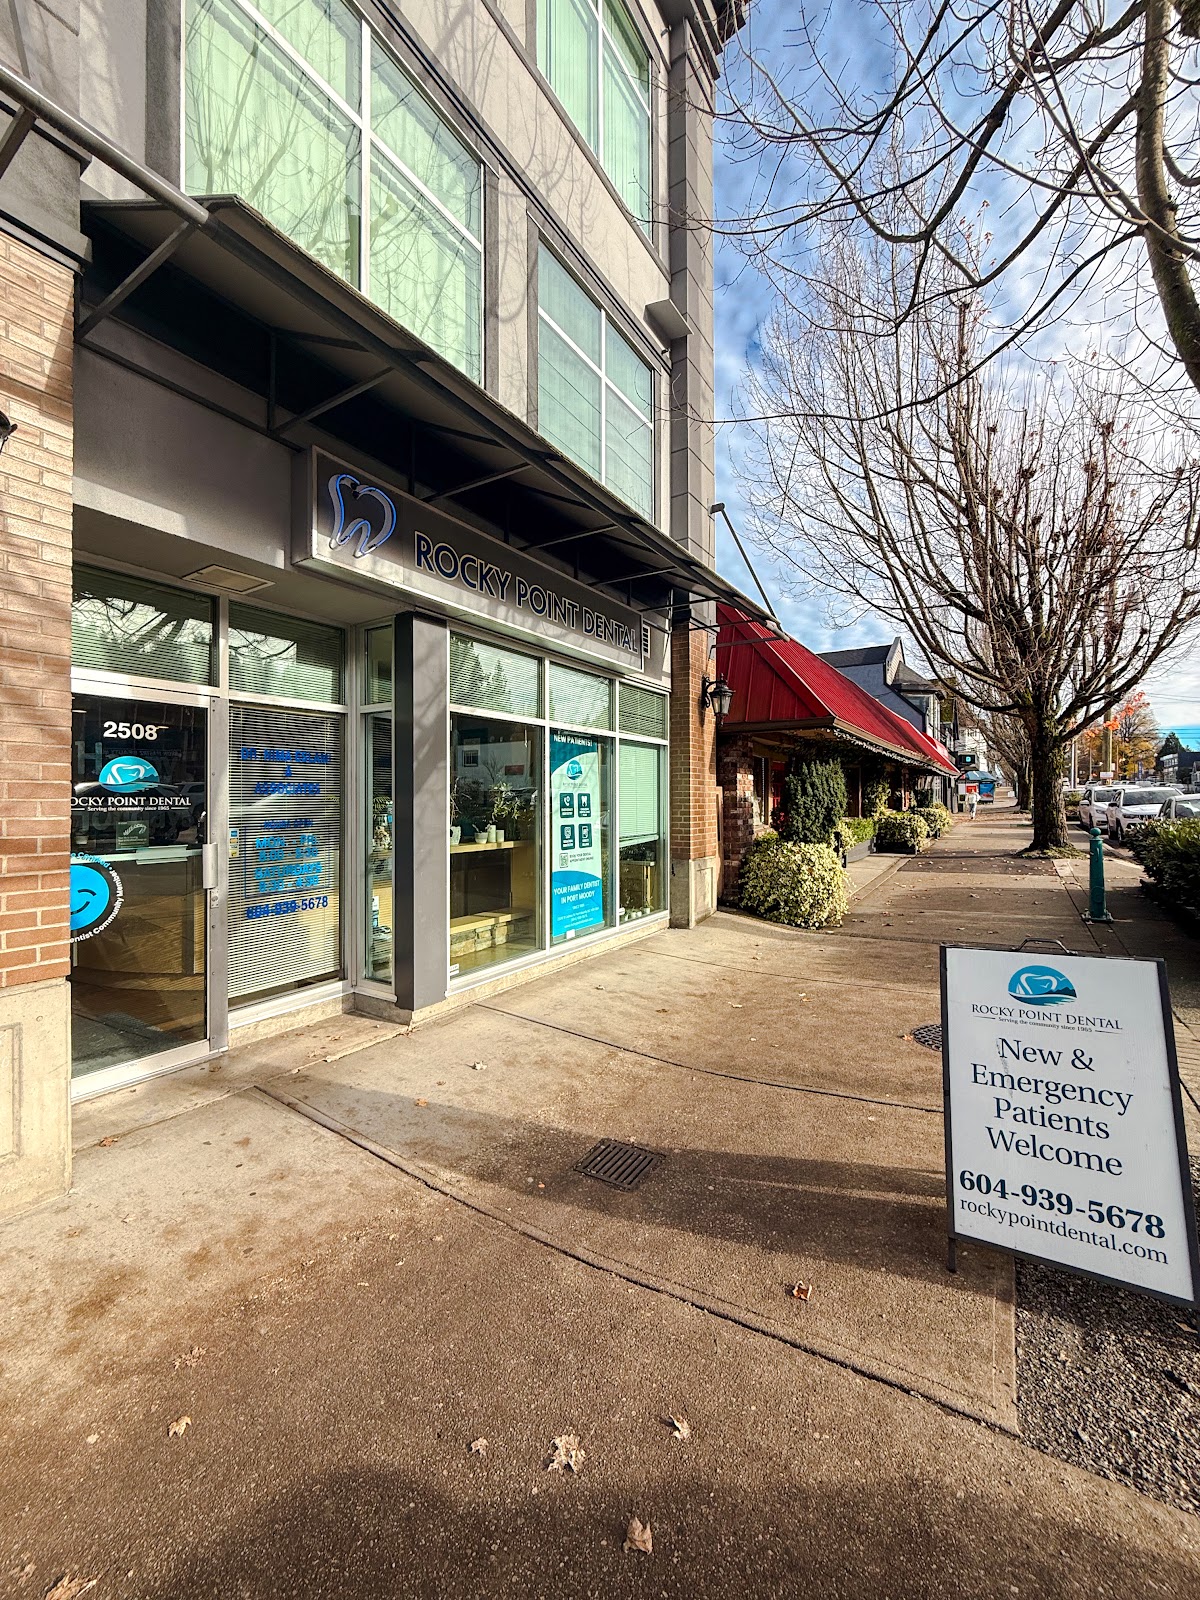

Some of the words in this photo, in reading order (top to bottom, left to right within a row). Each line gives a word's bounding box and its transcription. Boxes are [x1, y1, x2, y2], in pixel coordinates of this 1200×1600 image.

[414, 530, 512, 601] ROCKY
[515, 576, 579, 629] POINT
[582, 606, 639, 654] DENTAL
[103, 721, 158, 740] 2508
[553, 734, 567, 743] NEW
[254, 782, 321, 795] ASSOCIATES
[70, 796, 105, 806] OCKY
[107, 796, 147, 806] POINT
[149, 796, 192, 807] DENTAL
[254, 862, 322, 880] SATURDAYS
[553, 886, 568, 896] YOUR
[567, 882, 583, 893] FAMILY
[583, 880, 601, 890] DENTIST
[560, 896, 567, 905] IN
[566, 893, 579, 904] PORT
[578, 890, 595, 900] MOODY
[246, 896, 328, 919] 604-939-5678
[70, 931, 94, 944] entist
[92, 897, 125, 935] Community
[971, 1003, 1015, 1017] ROCKY
[1018, 1009, 1062, 1023] POINT
[1066, 1014, 1123, 1030] DENTAL
[998, 1016, 1019, 1025] Serving
[1029, 1021, 1060, 1029] community
[999, 1037, 1063, 1067] New
[1071, 1048, 1095, 1072] &
[970, 1063, 1134, 1116] Emergency
[993, 1097, 1111, 1140] Patients
[985, 1126, 1123, 1176] Welcome
[959, 1169, 1166, 1240] 604-939-5678
[960, 1197, 1169, 1265] rockypointdental.com
